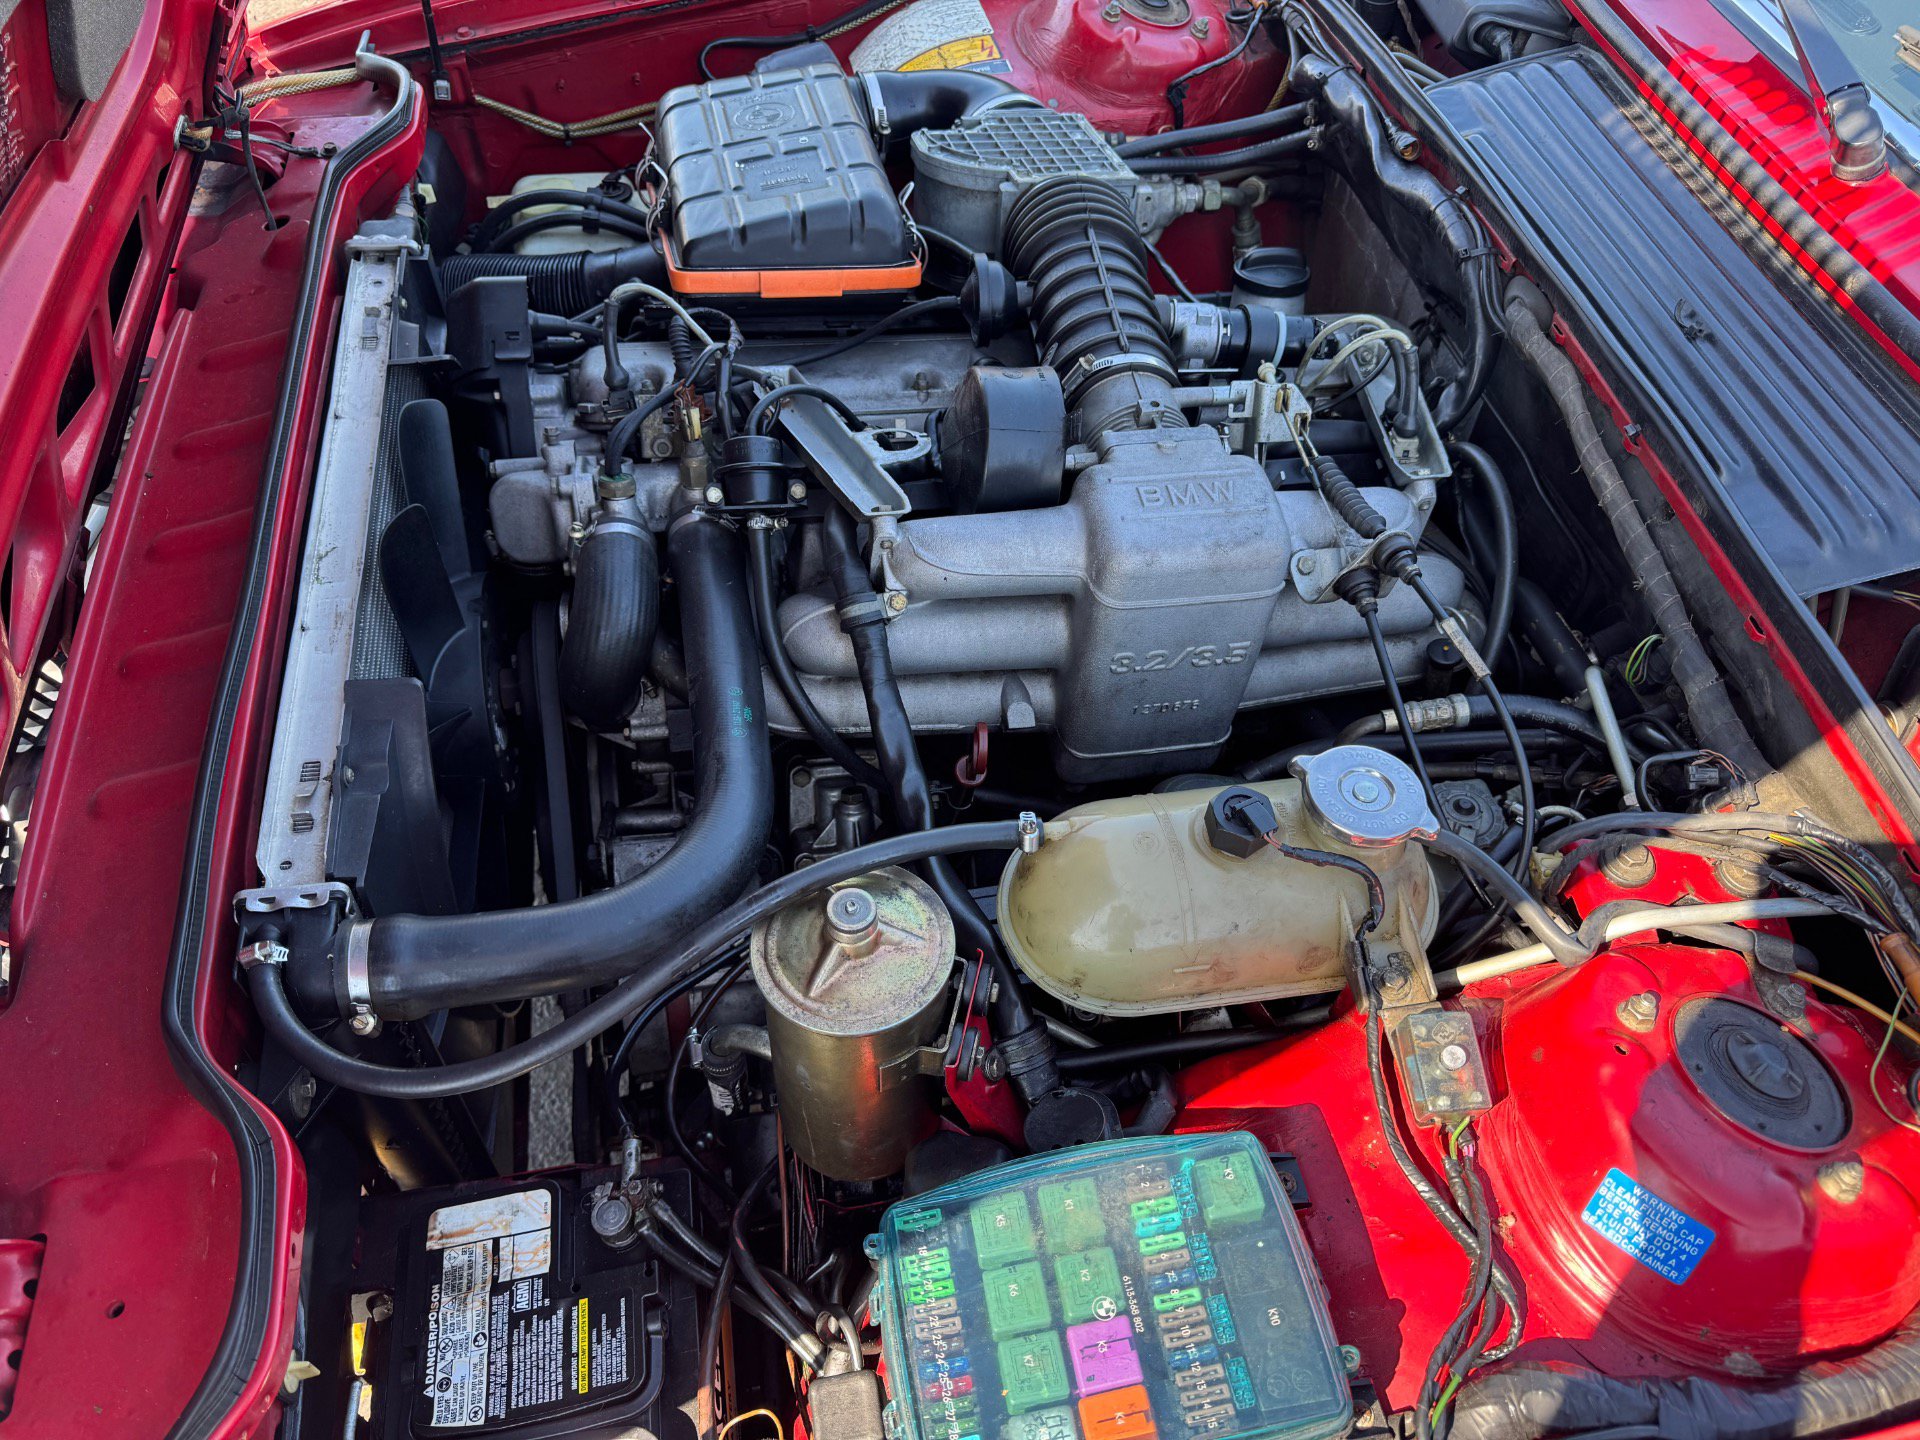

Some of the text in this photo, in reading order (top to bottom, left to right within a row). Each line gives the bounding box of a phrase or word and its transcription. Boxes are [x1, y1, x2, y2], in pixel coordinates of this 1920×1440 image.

[1136, 481, 1236, 508] BMW
[1110, 641, 1252, 674] 3.2/3.5
[1223, 1167, 1234, 1180] K9
[1140, 1180, 1150, 1188] 2
[1064, 1199, 1074, 1210] K1
[1633, 1186, 1685, 1224] WARNING
[1604, 1178, 1704, 1245] CLEAN FILLER CAP
[995, 1214, 1005, 1226] K5
[1599, 1187, 1698, 1255] BEFORE REMOVING
[914, 1224, 924, 1232] 17
[1599, 1200, 1620, 1218] USE
[1653, 1235, 1676, 1254] DOT
[1595, 1209, 1676, 1267] FLUID FROM A
[917, 1245, 927, 1255] 18
[1079, 1268, 1090, 1281] K2
[923, 1279, 932, 1290] 20
[1008, 1283, 1018, 1296] K6
[516, 1281, 529, 1308] AGM
[925, 1297, 935, 1306] 21
[928, 1315, 939, 1327] 22
[1267, 1308, 1280, 1326] K10
[1133, 1317, 1144, 1333] 802
[1180, 1324, 1190, 1336] 10
[425, 1284, 440, 1384] DANGER/POISON
[932, 1333, 941, 1345] 23
[1096, 1340, 1108, 1353] K3
[935, 1352, 944, 1365] 24
[1023, 1354, 1034, 1367] K7
[1190, 1361, 1201, 1372] 12
[938, 1371, 948, 1384] 25
[580, 1382, 586, 1390] DO
[1195, 1380, 1207, 1391] 13
[941, 1390, 951, 1402] 26
[1200, 1398, 1212, 1408] 14
[442, 1397, 450, 1423] EXPLOSIVE
[944, 1410, 956, 1421] 27
[1114, 1411, 1125, 1424] K4
[1206, 1417, 1218, 1429] 15
[947, 1428, 959, 1440] 28
